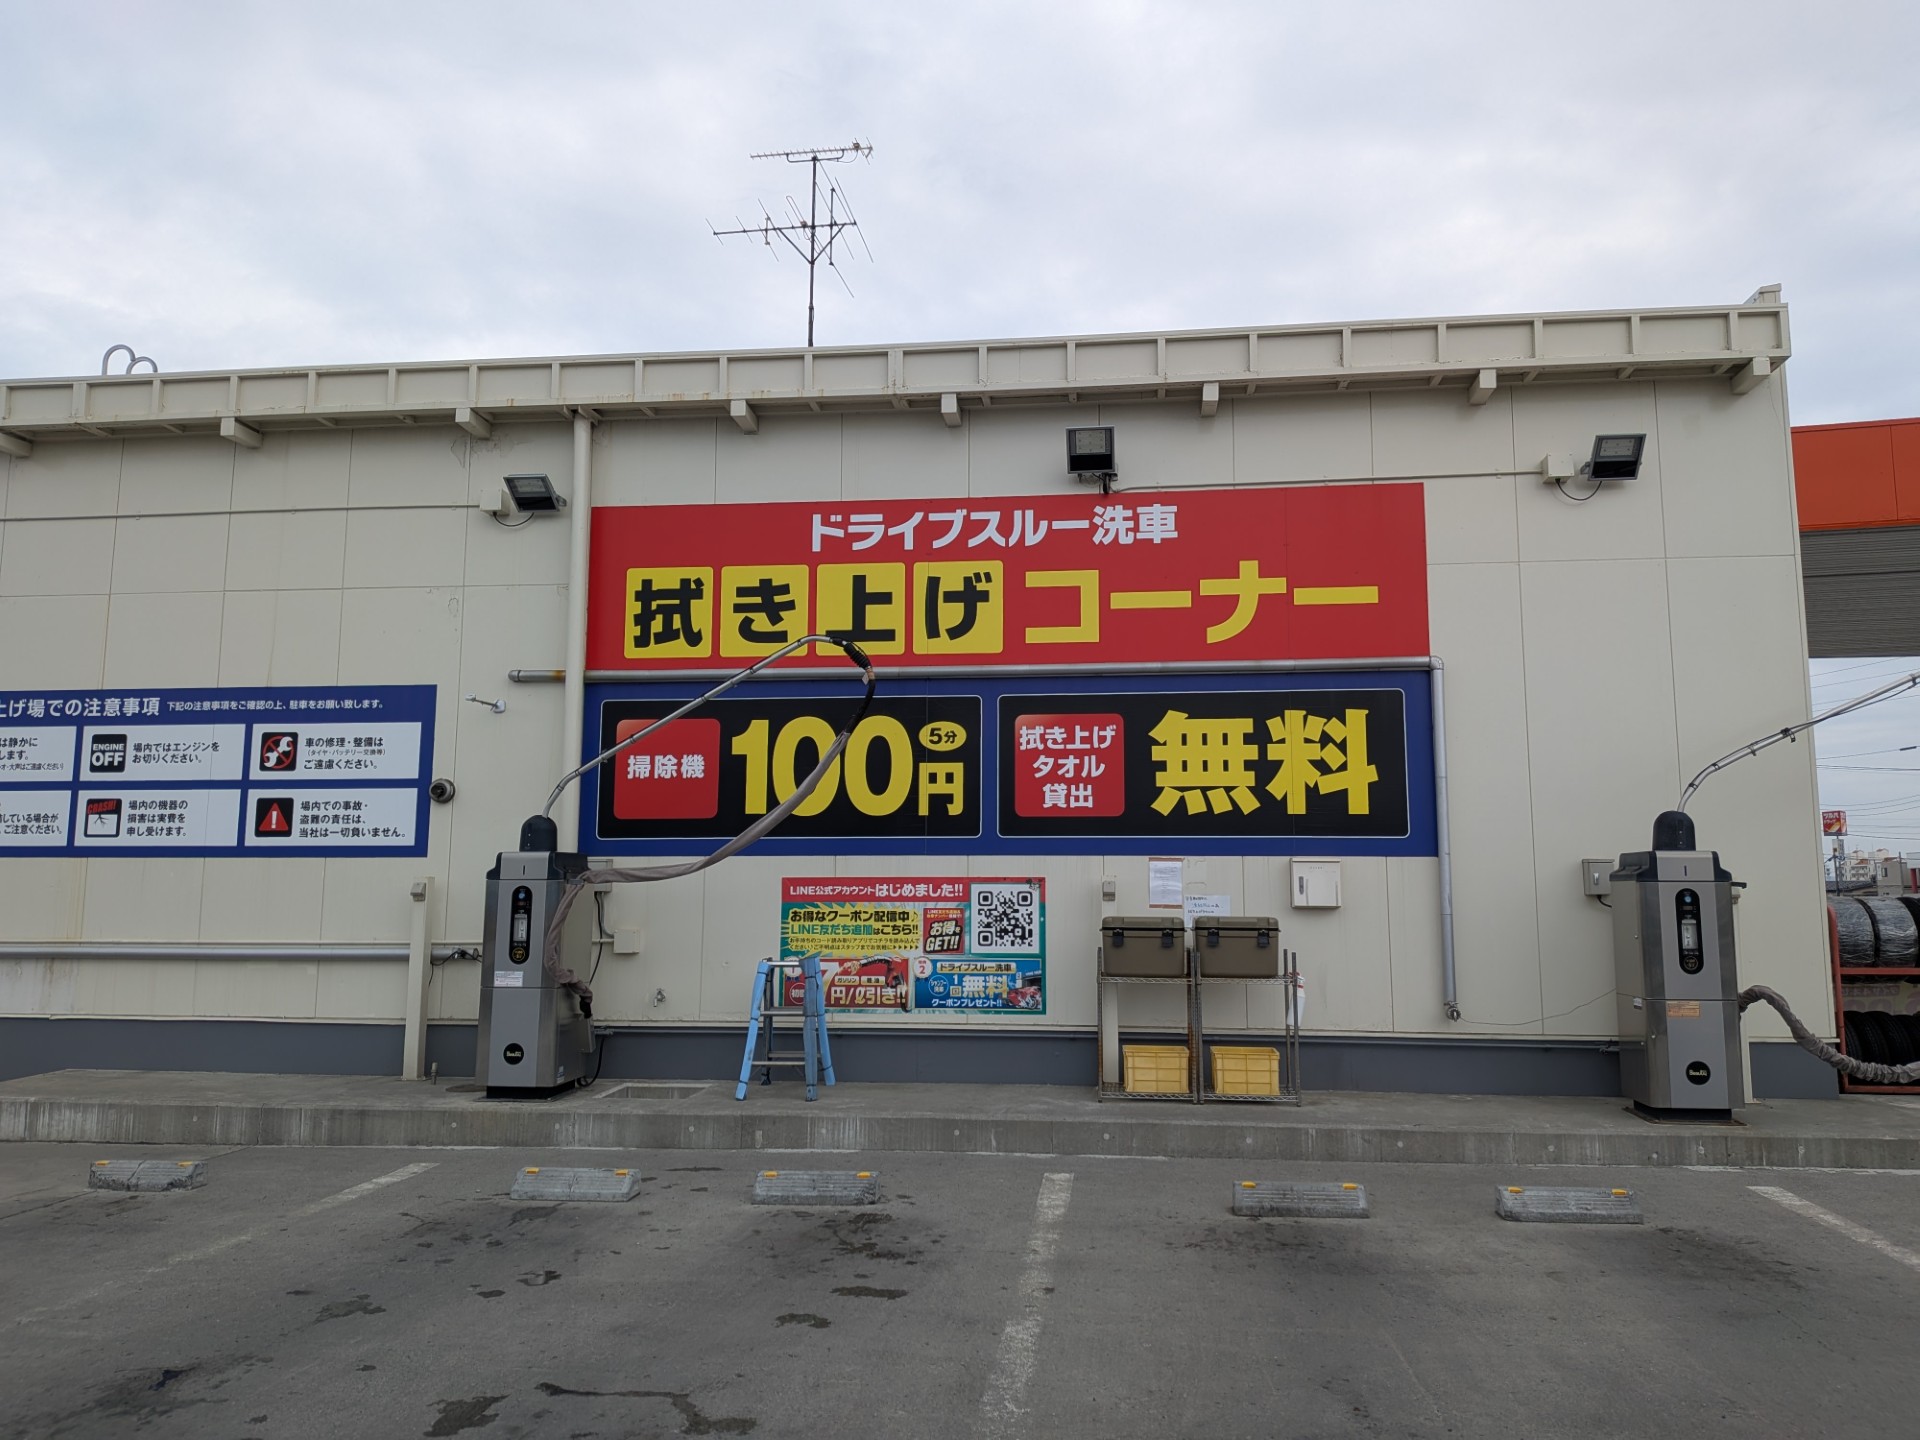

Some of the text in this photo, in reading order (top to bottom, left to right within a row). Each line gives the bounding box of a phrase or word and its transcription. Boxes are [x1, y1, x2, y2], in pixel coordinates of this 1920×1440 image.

[812, 503, 1178, 552] ドライブスルー洗車
[633, 560, 1378, 648] 拭き上げコーナー
[167, 699, 383, 711] 下記の注意事項をご確認の上、駐車をお願い致します。
[929, 727, 957, 744] 5分
[1019, 724, 1116, 751] 拭き上げ
[93, 743, 125, 751] ENGINE
[133, 742, 220, 753] 場内ではエンジンを
[305, 737, 383, 747] 車の修理・整備は
[91, 752, 124, 766] OFF
[132, 753, 202, 763] お切りください。
[1148, 709, 1379, 816] 無料
[304, 759, 378, 769] ご遠慮ください。
[627, 754, 705, 780] 掃除機
[1032, 755, 1105, 778] タオル
[1042, 783, 1093, 809] 貸出
[87, 800, 117, 815] CRASH!
[128, 800, 188, 810] 場内の機器の
[127, 813, 186, 823] 損害は実費を
[299, 814, 366, 824] 盗難の責任は、
[126, 826, 187, 837] 申し受けます。
[299, 827, 405, 837] 当社は一切負いません。
[790, 883, 963, 897] LINE公式アカウントはじめました!!
[791, 924, 918, 935] LINE友だち追加はこちら!!
[925, 936, 960, 951] GET!!
[919, 965, 925, 974] 2
[940, 963, 1012, 971] ドライブスルー洗車
[963, 975, 1009, 998] 無料
[932, 998, 1002, 1007] クーポンプレゼント!!
